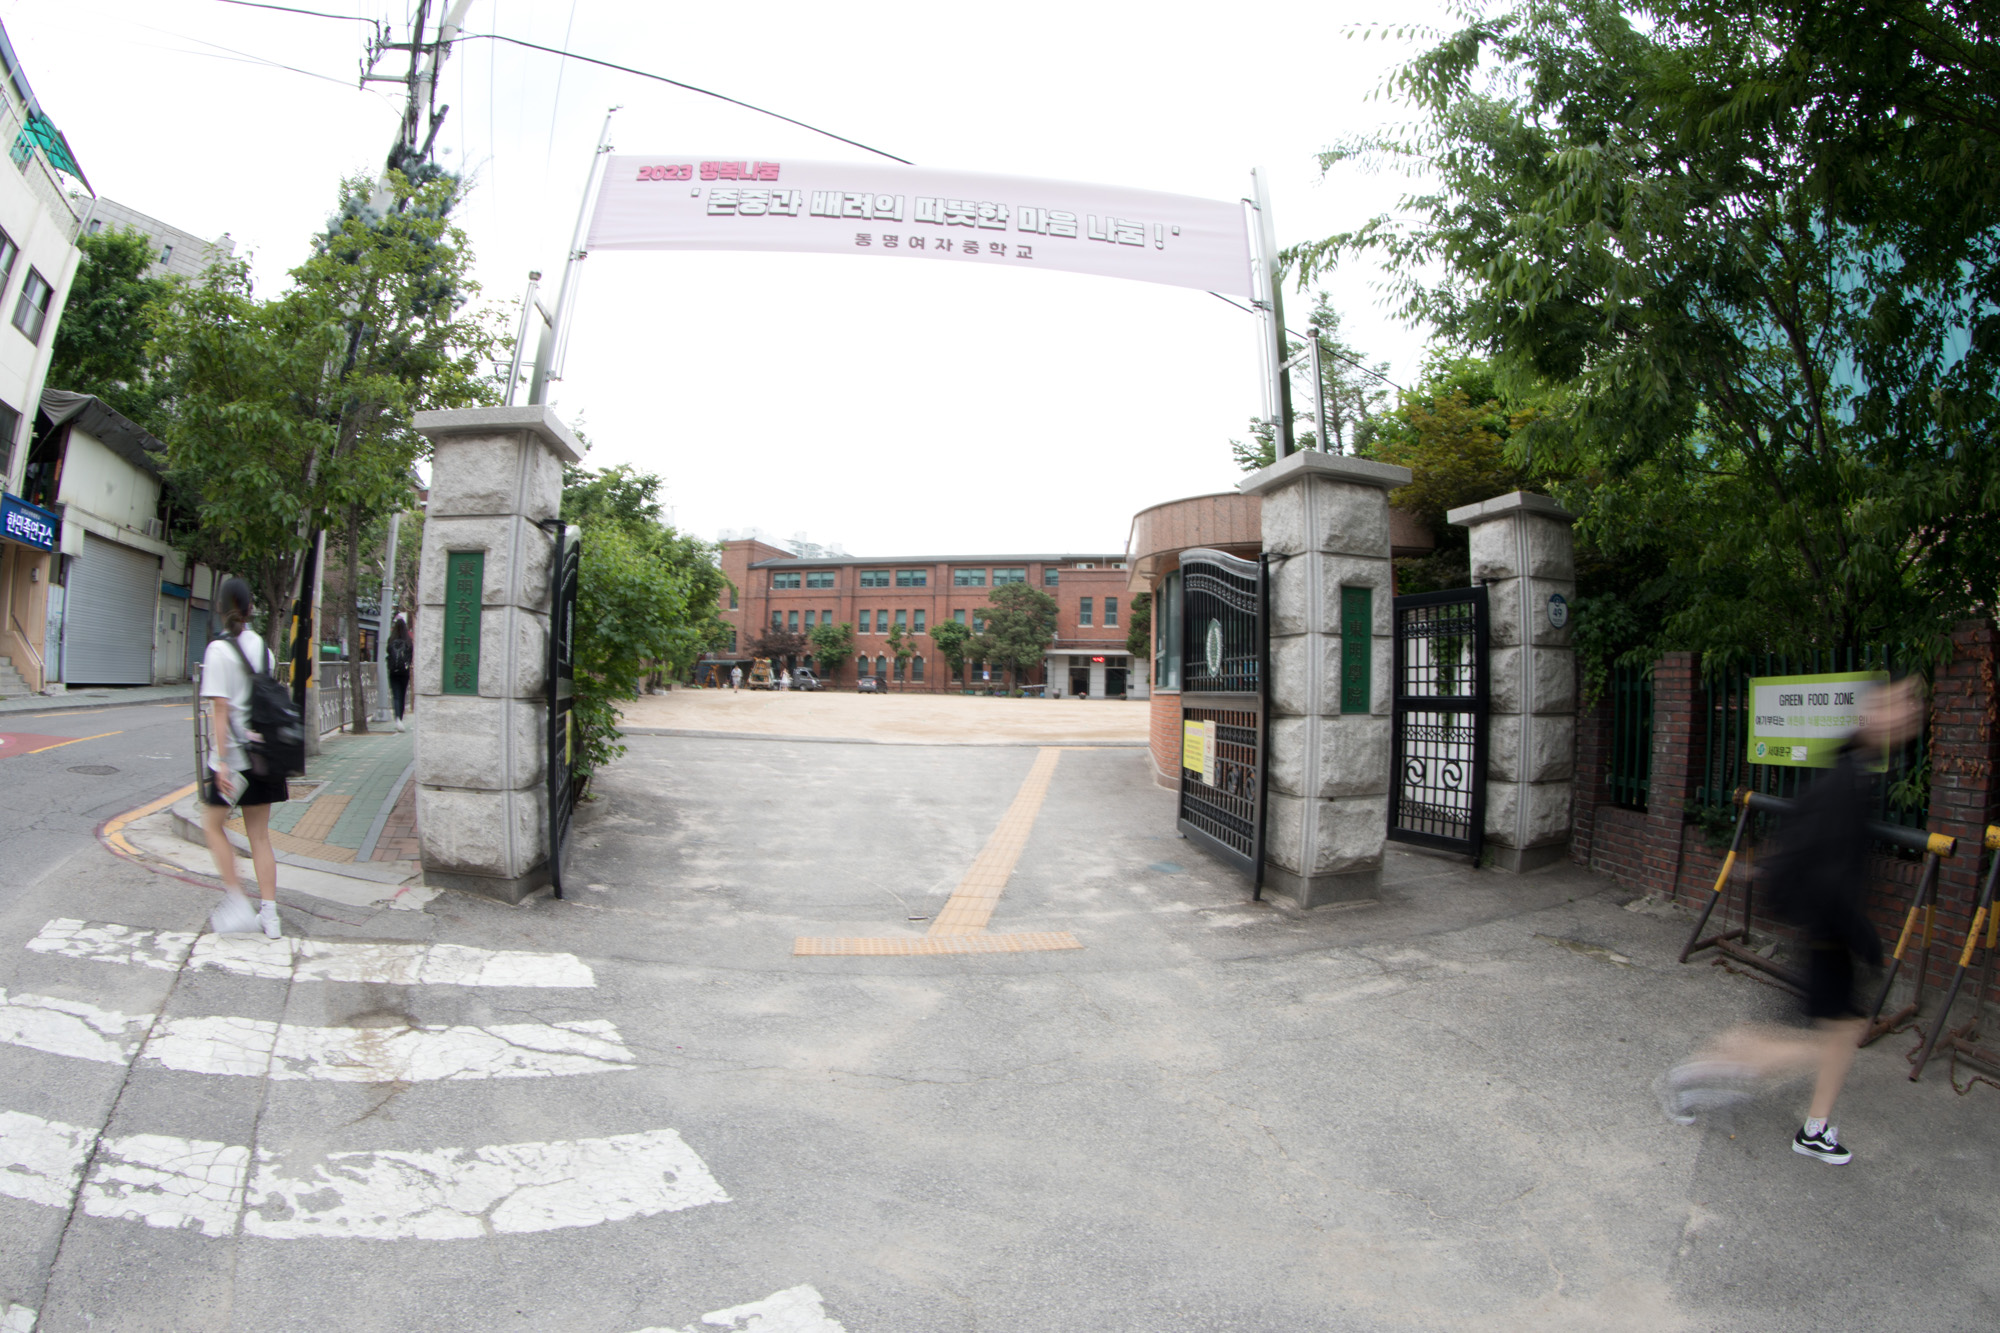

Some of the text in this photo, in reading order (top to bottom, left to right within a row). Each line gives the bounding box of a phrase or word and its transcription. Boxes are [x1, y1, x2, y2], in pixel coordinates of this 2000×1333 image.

[636, 161, 780, 181] 2023 행복나눔
[810, 190, 905, 222] 배려의
[914, 196, 1010, 231] 따뜻한
[1017, 206, 1078, 239] 마음
[855, 233, 1034, 260] 동명여자중학교
[6, 511, 54, 546] 한민족연구소
[453, 560, 477, 689] 東明女子中學校
[1779, 692, 1855, 706] GREEN FOOD ZONE
[1755, 715, 1785, 727] 여기부터는
[1768, 746, 1791, 757] 서대문구
